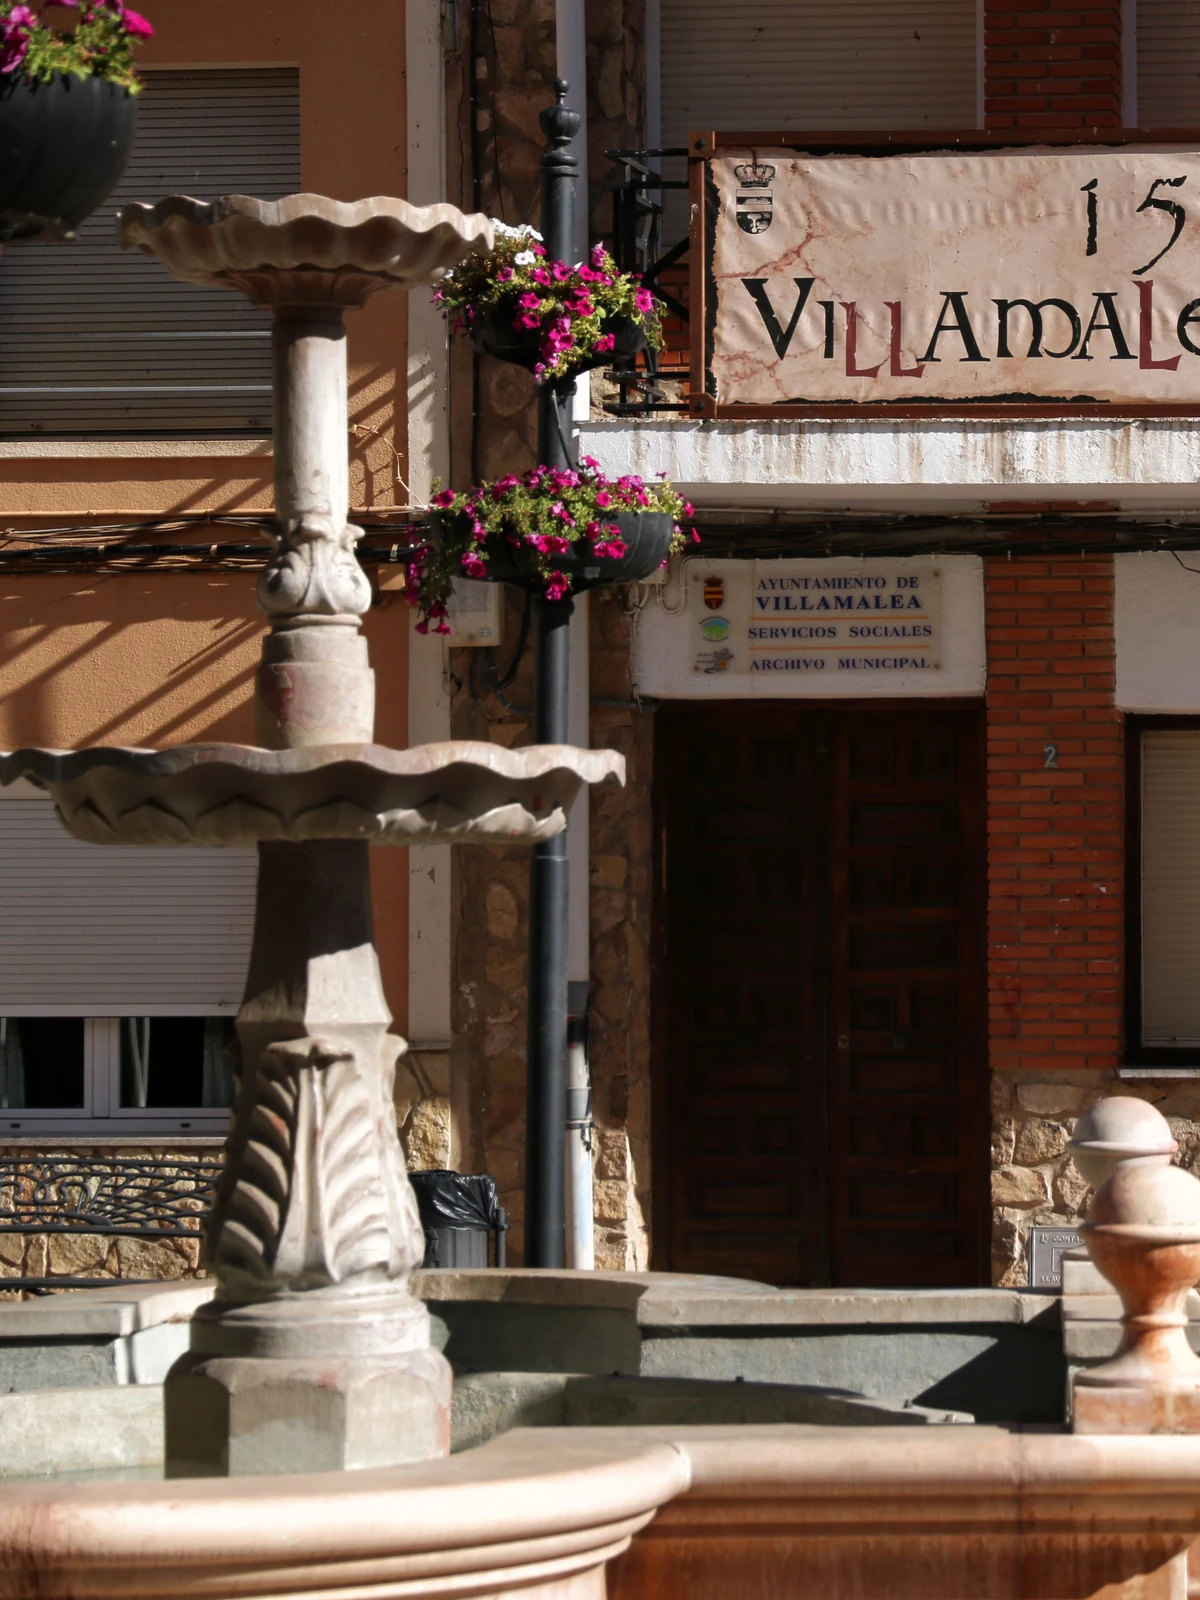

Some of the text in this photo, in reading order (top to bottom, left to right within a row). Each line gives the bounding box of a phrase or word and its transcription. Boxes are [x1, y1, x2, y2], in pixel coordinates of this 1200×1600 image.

[757, 576, 919, 591] AYUNTAMIENTO DE
[755, 594, 922, 612] VILLAMALEA
[747, 625, 933, 640] SERVICIOS SOCIALES
[749, 657, 931, 671] ARCHIVO MUNICIPAL
[1043, 745, 1058, 768] 2
